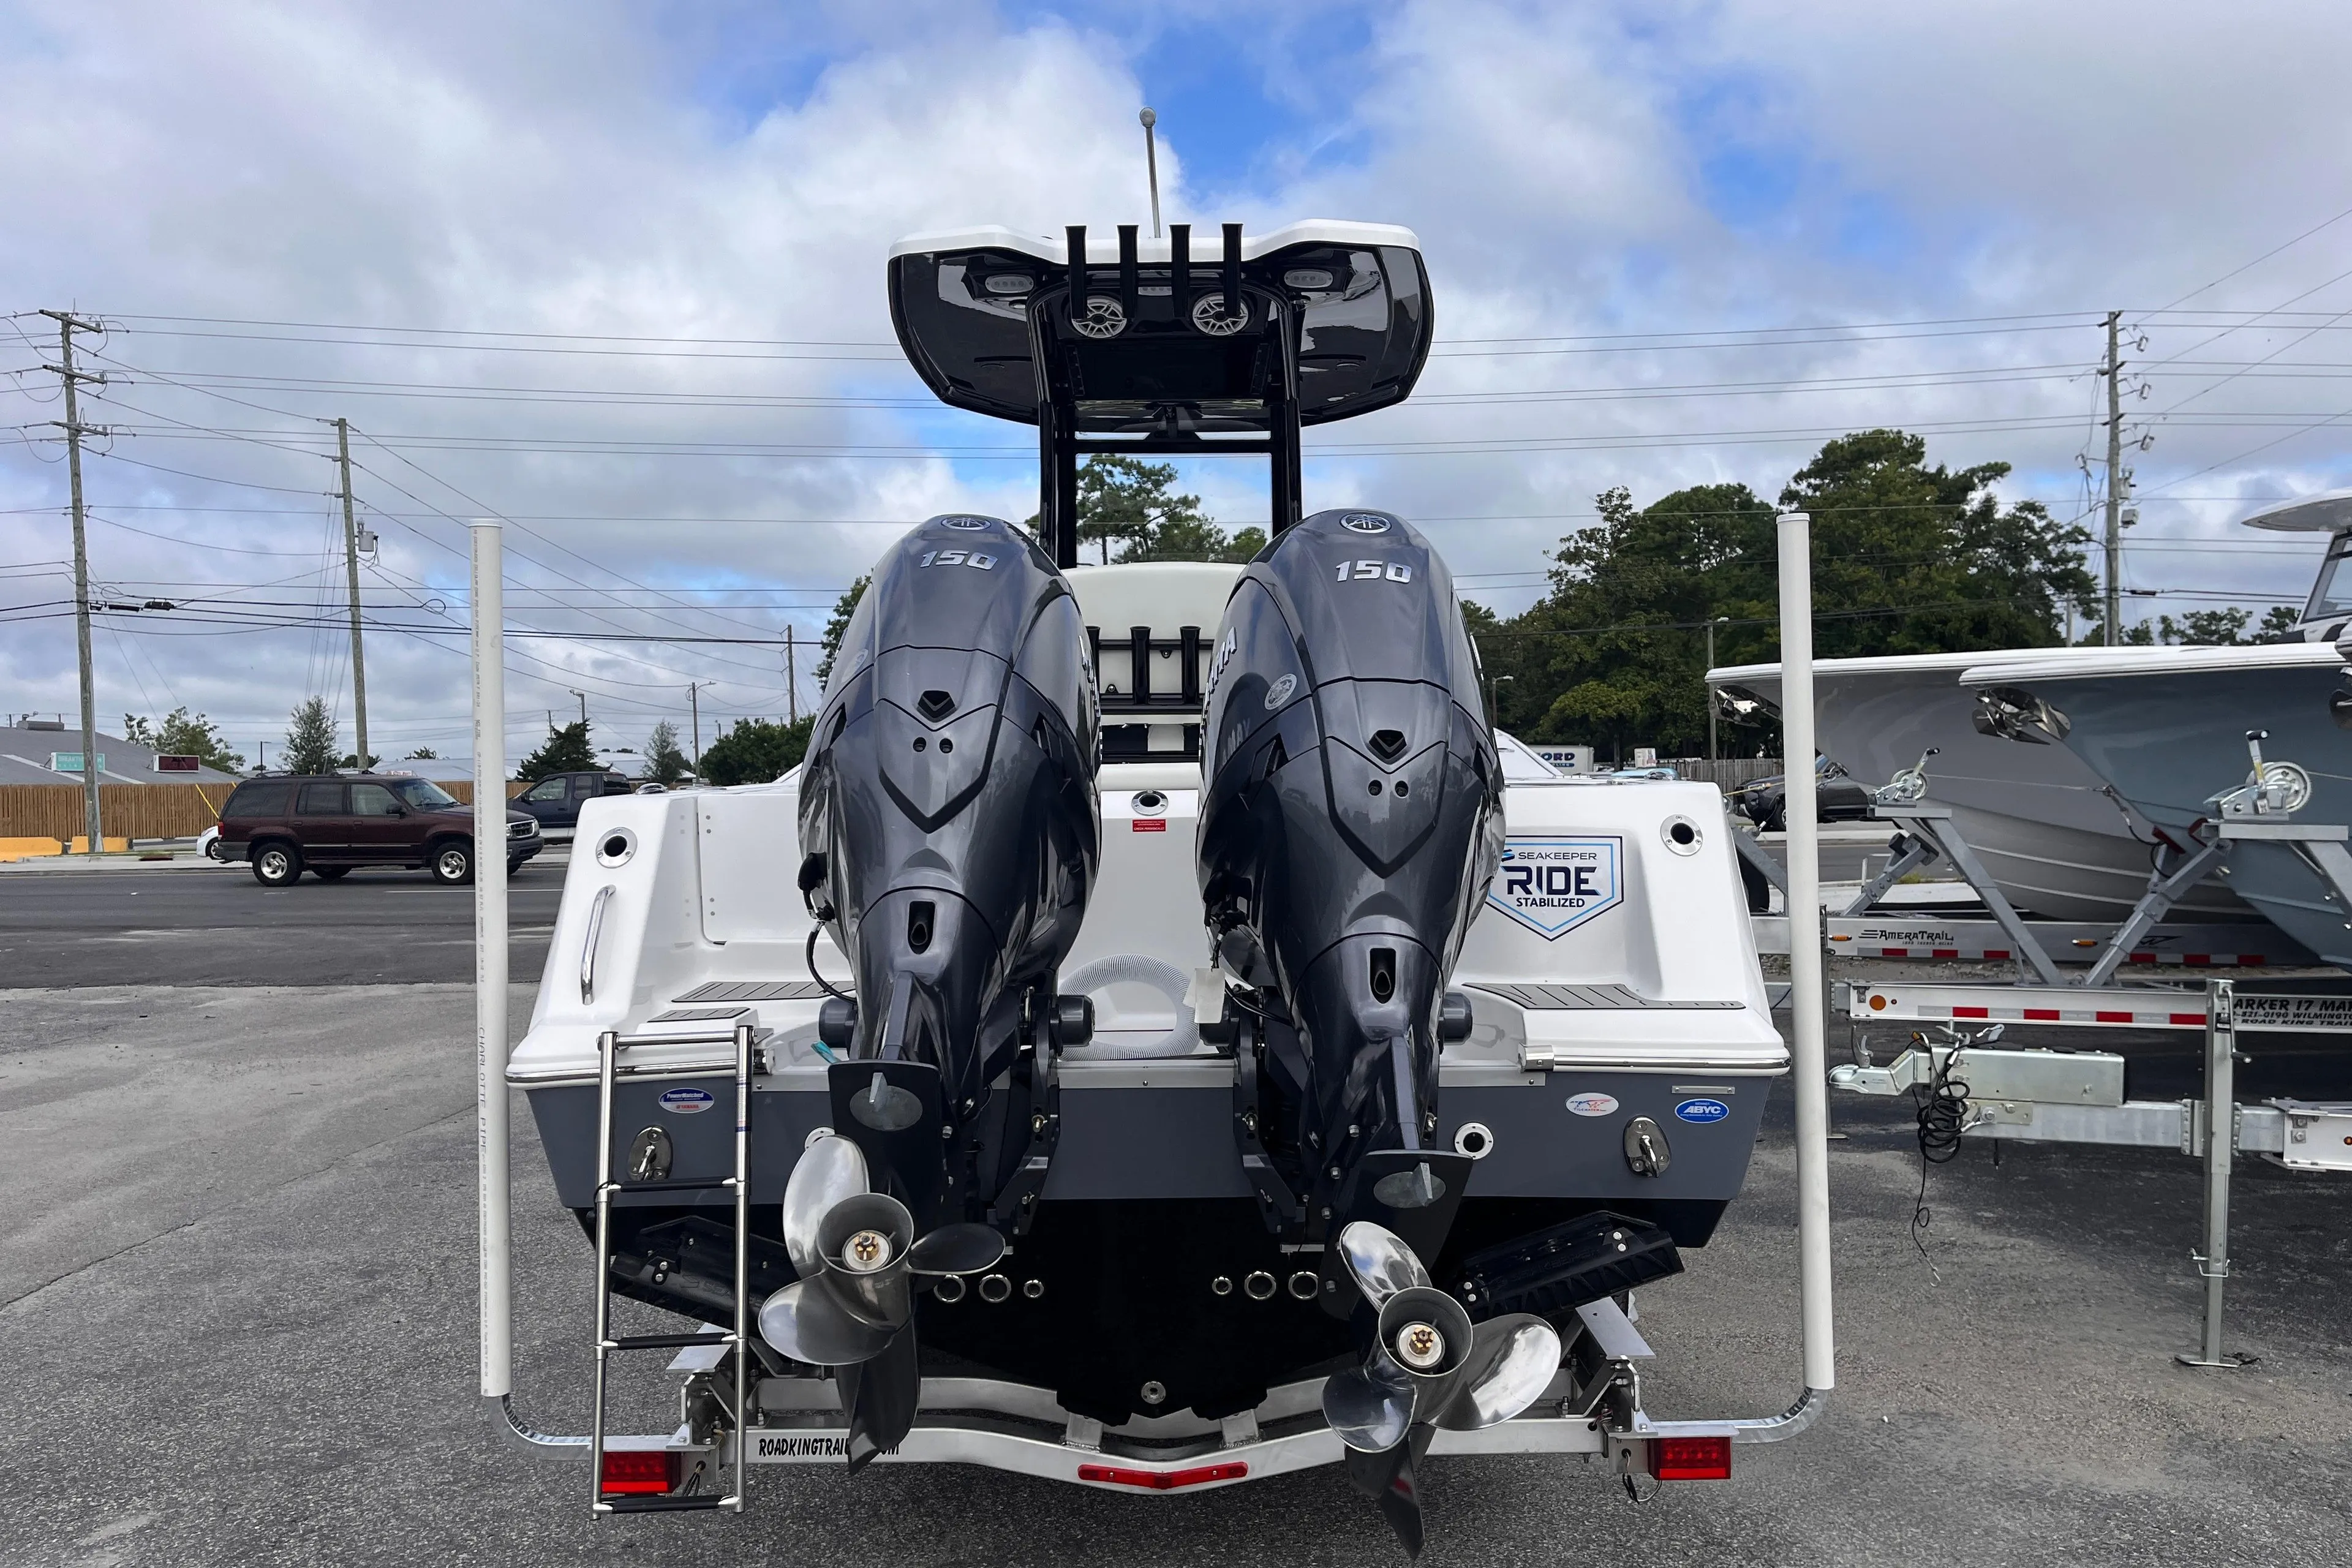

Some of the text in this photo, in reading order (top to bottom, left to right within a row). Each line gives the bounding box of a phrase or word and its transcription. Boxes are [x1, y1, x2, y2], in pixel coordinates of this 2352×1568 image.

[920, 550, 998, 570] 150
[1336, 560, 1412, 584] 150
[1501, 866, 1602, 896] RIDE
[1516, 898, 1585, 908] STABILIZED
[2234, 998, 2290, 1011] ARKER
